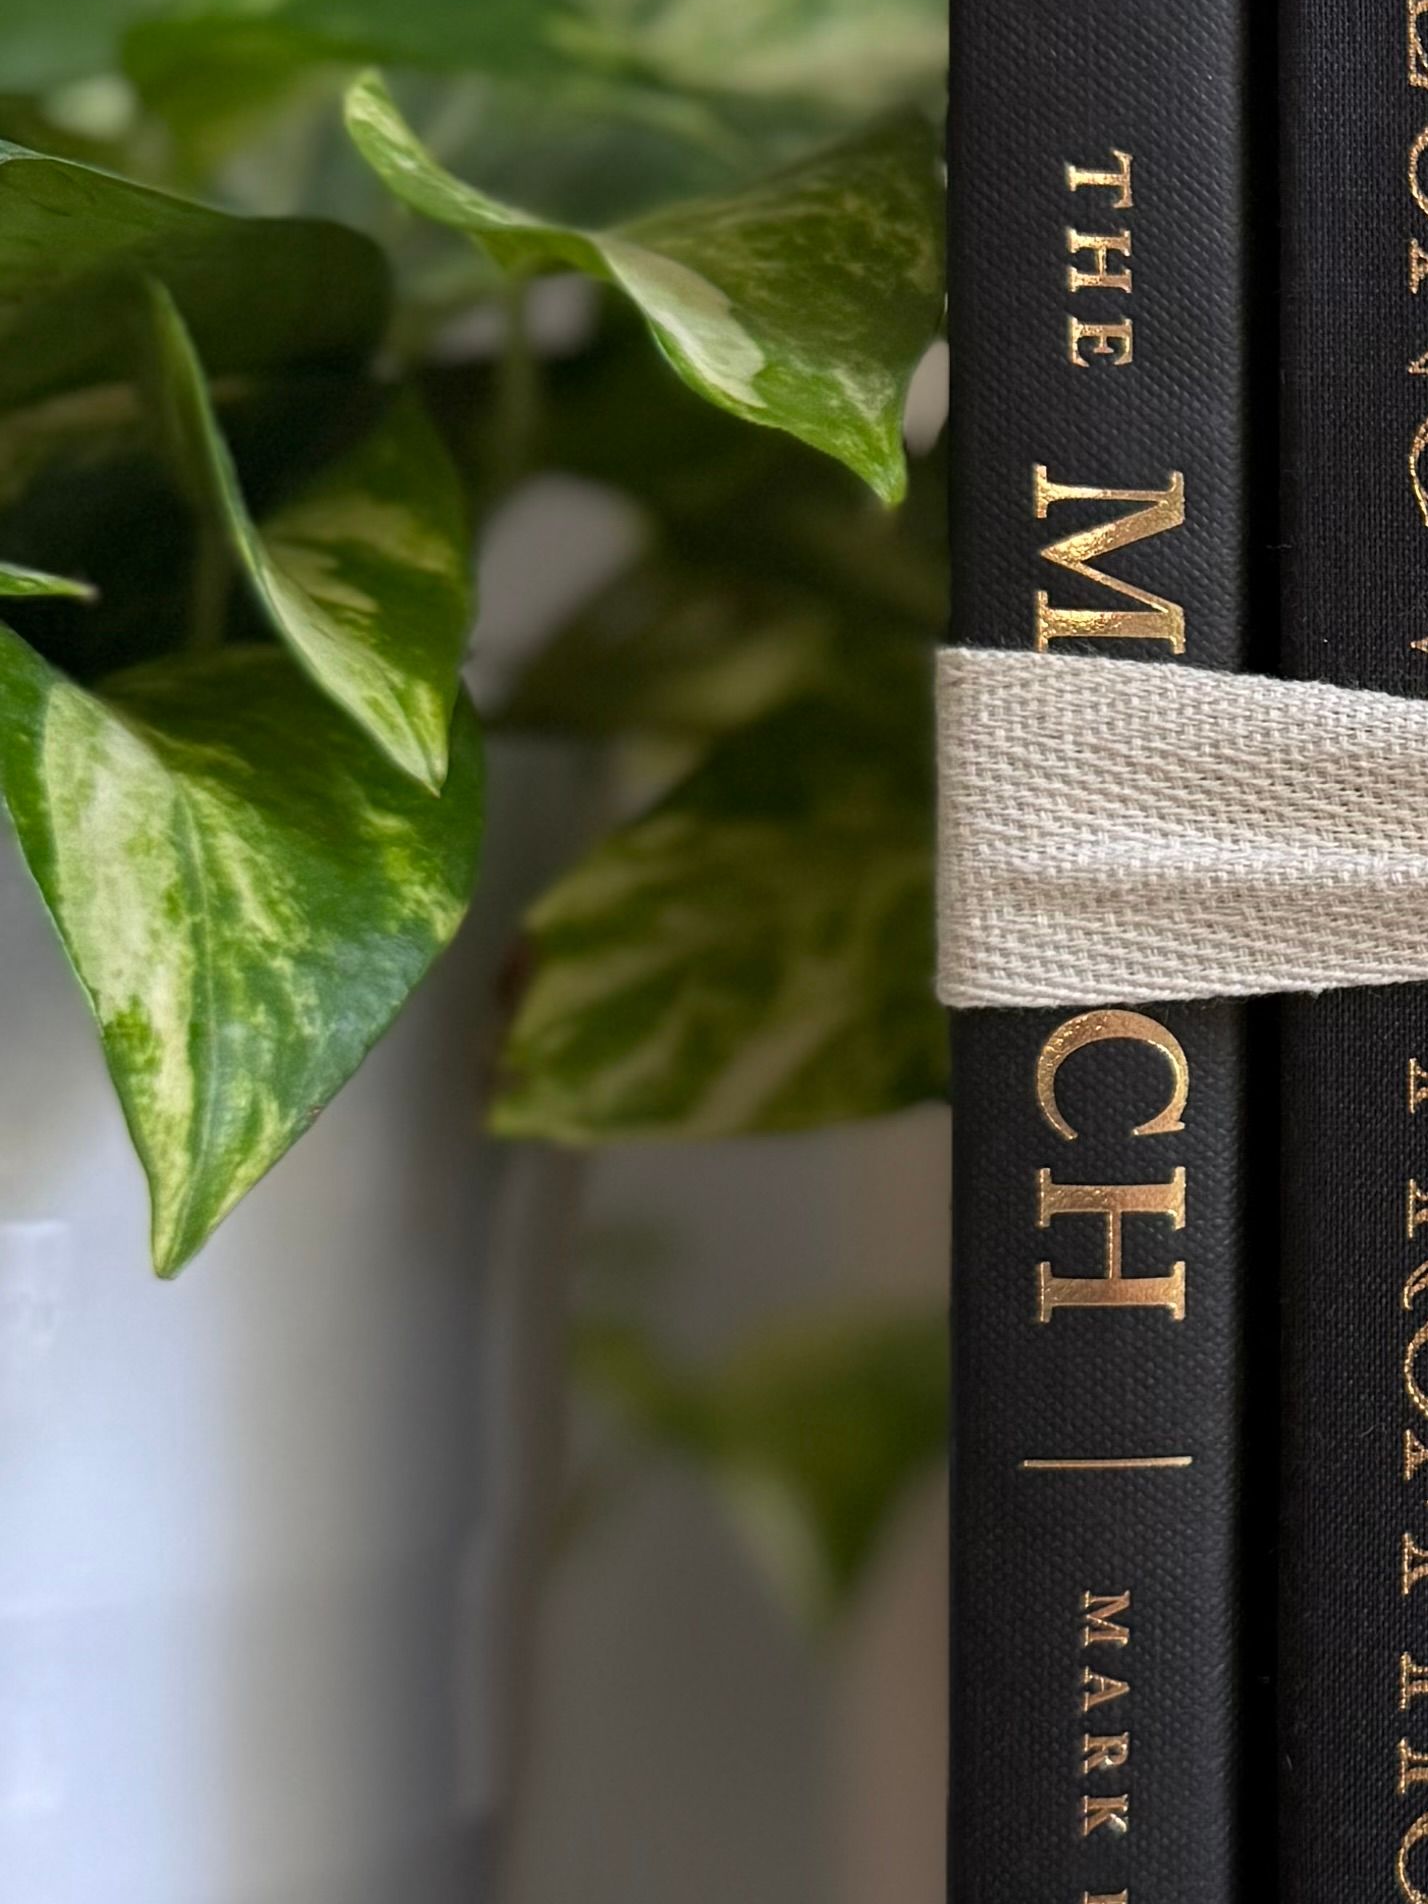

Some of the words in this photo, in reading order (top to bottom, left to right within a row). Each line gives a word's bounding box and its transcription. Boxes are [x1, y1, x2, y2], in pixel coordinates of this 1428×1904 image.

[1066, 150, 1133, 368] THE
[1034, 465, 1189, 1322] MCH
[1082, 1591, 1129, 1835] MARK
